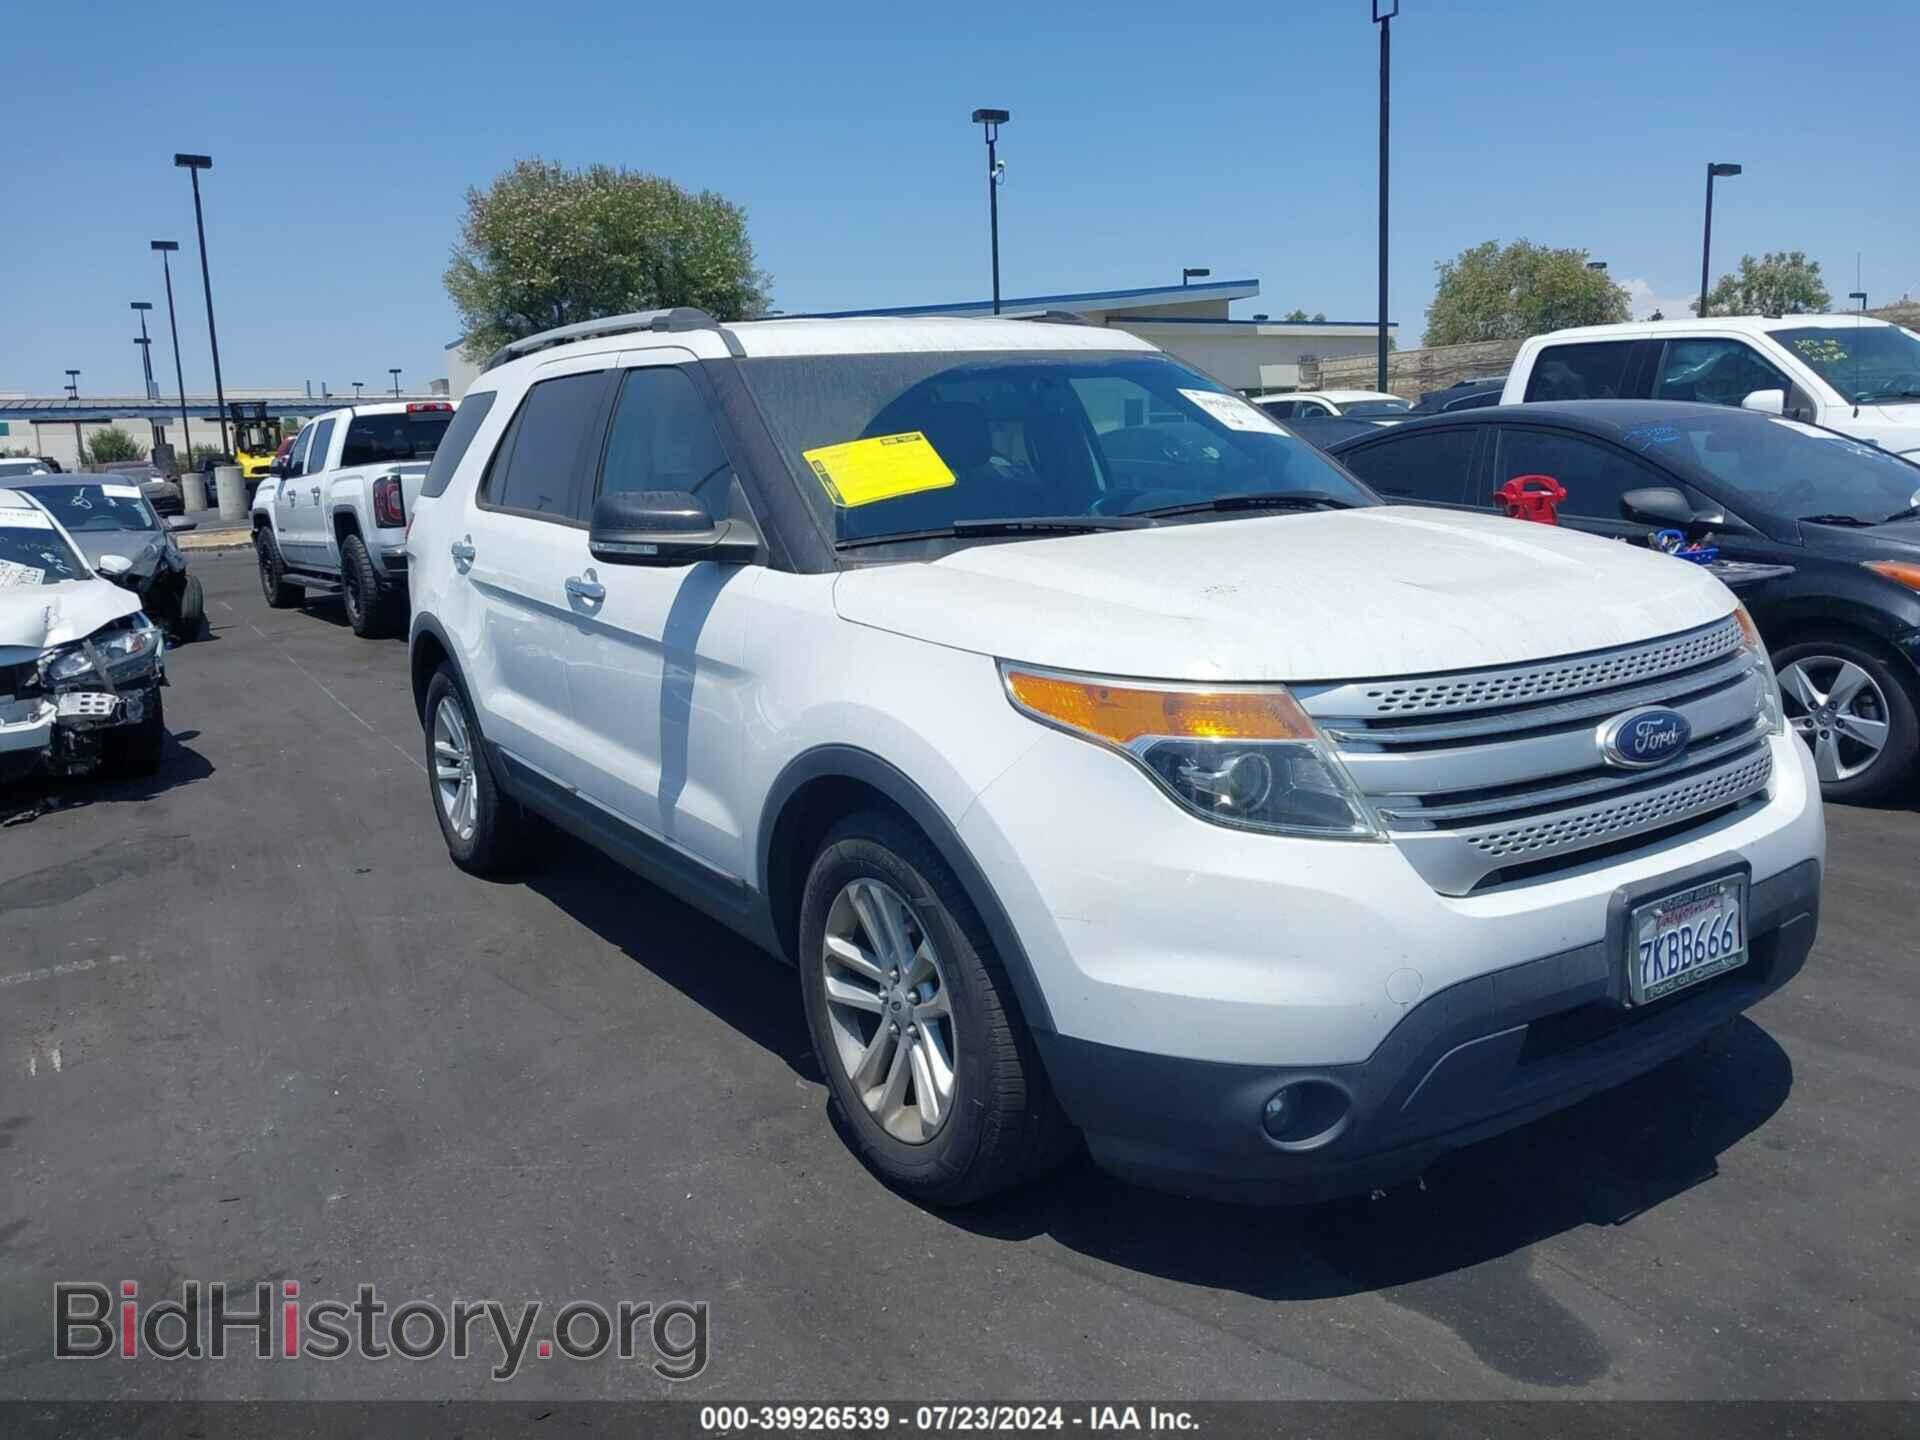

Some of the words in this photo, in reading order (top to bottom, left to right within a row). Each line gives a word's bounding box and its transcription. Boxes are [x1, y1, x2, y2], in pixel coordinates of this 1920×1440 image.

[1634, 719, 1683, 754] Ford
[1655, 897, 1722, 929] California
[1639, 911, 1735, 984] 7KBB666
